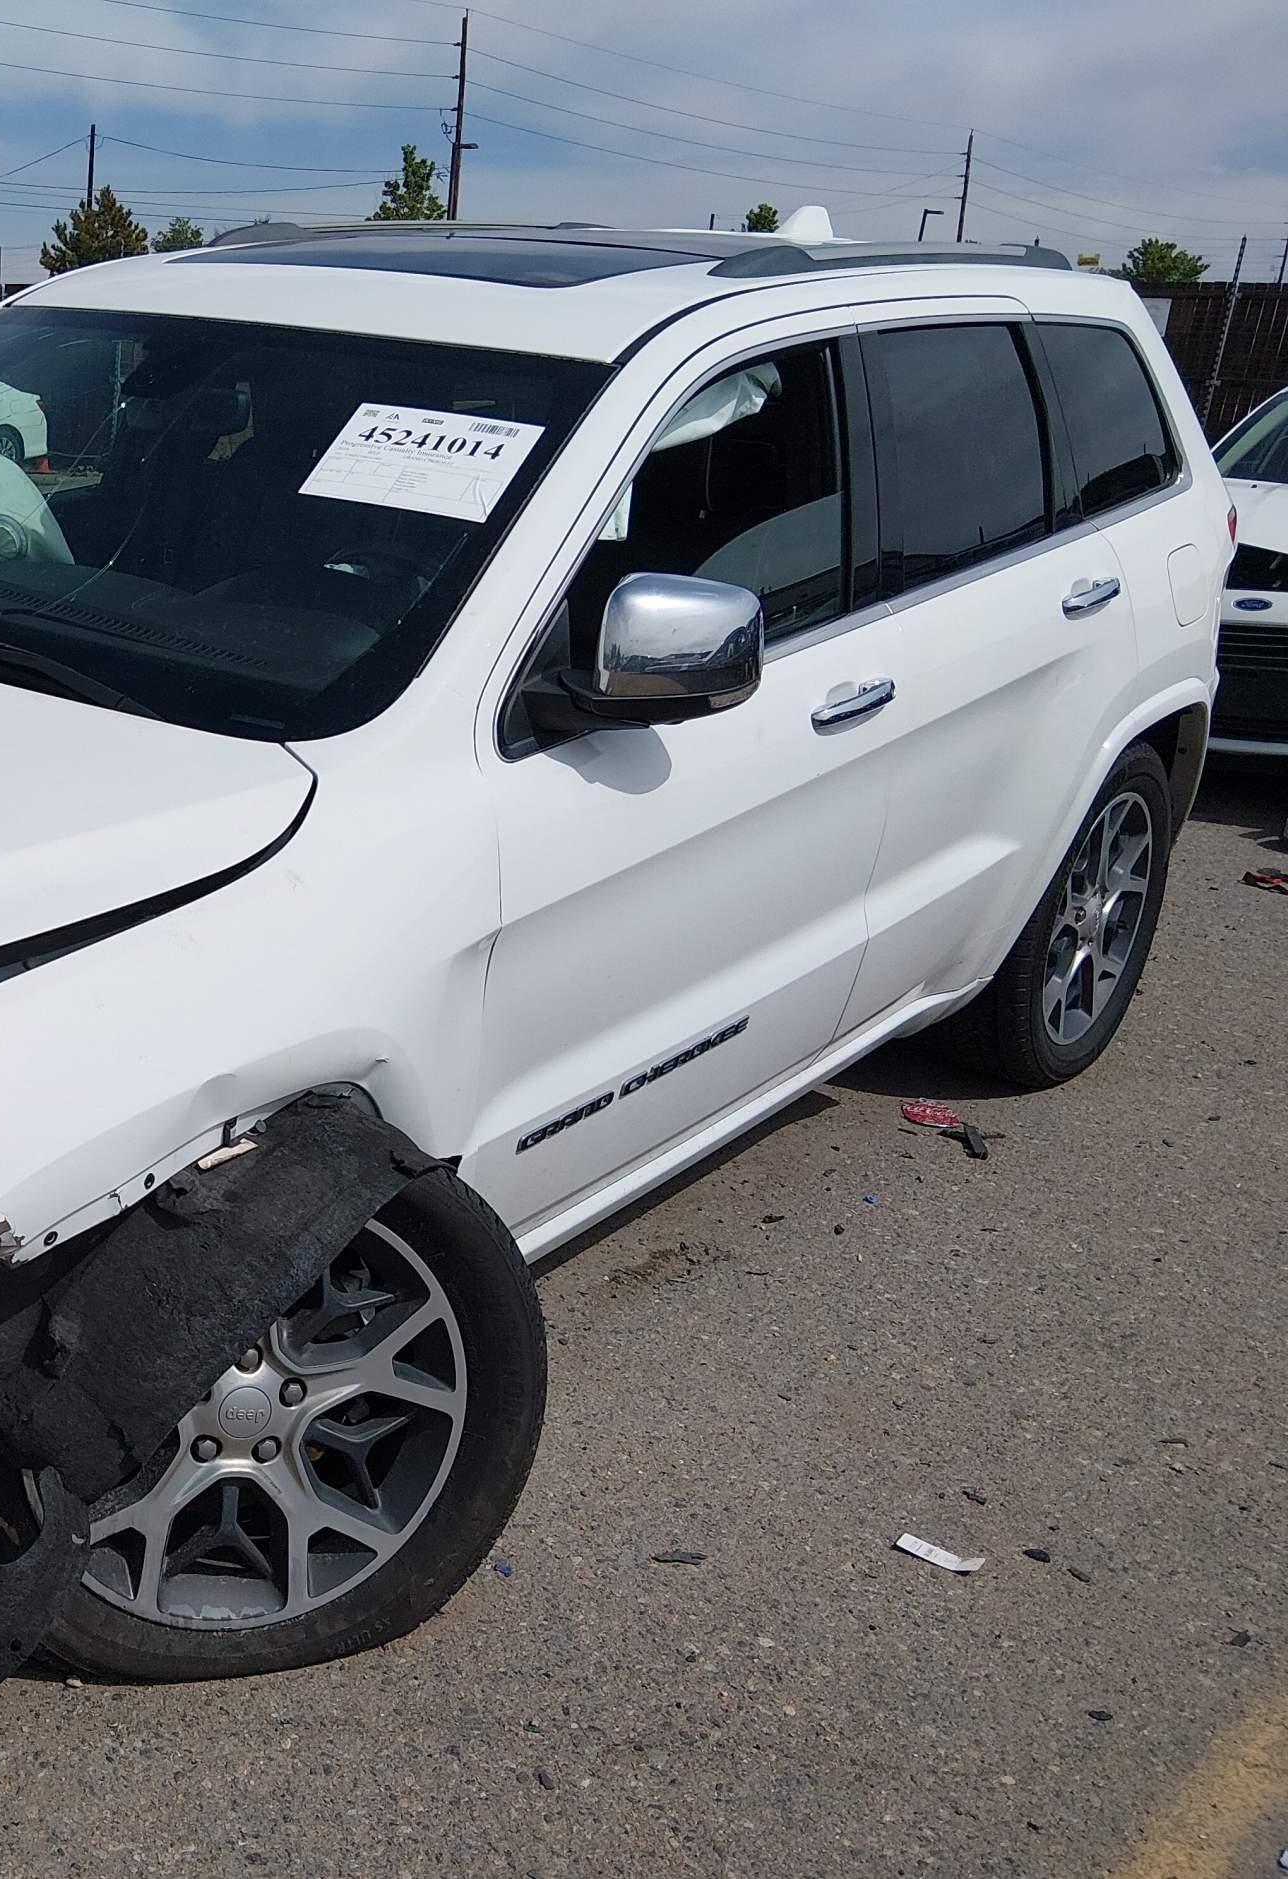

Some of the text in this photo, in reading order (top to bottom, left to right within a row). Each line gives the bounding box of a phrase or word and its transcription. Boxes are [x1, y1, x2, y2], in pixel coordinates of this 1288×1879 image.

[340, 439, 382, 450] Progressive
[384, 444, 415, 455] Casualty
[416, 449, 454, 460] Insurance
[358, 426, 505, 461] 45241014
[515, 1015, 751, 1155] GRAND CHEROKEE
